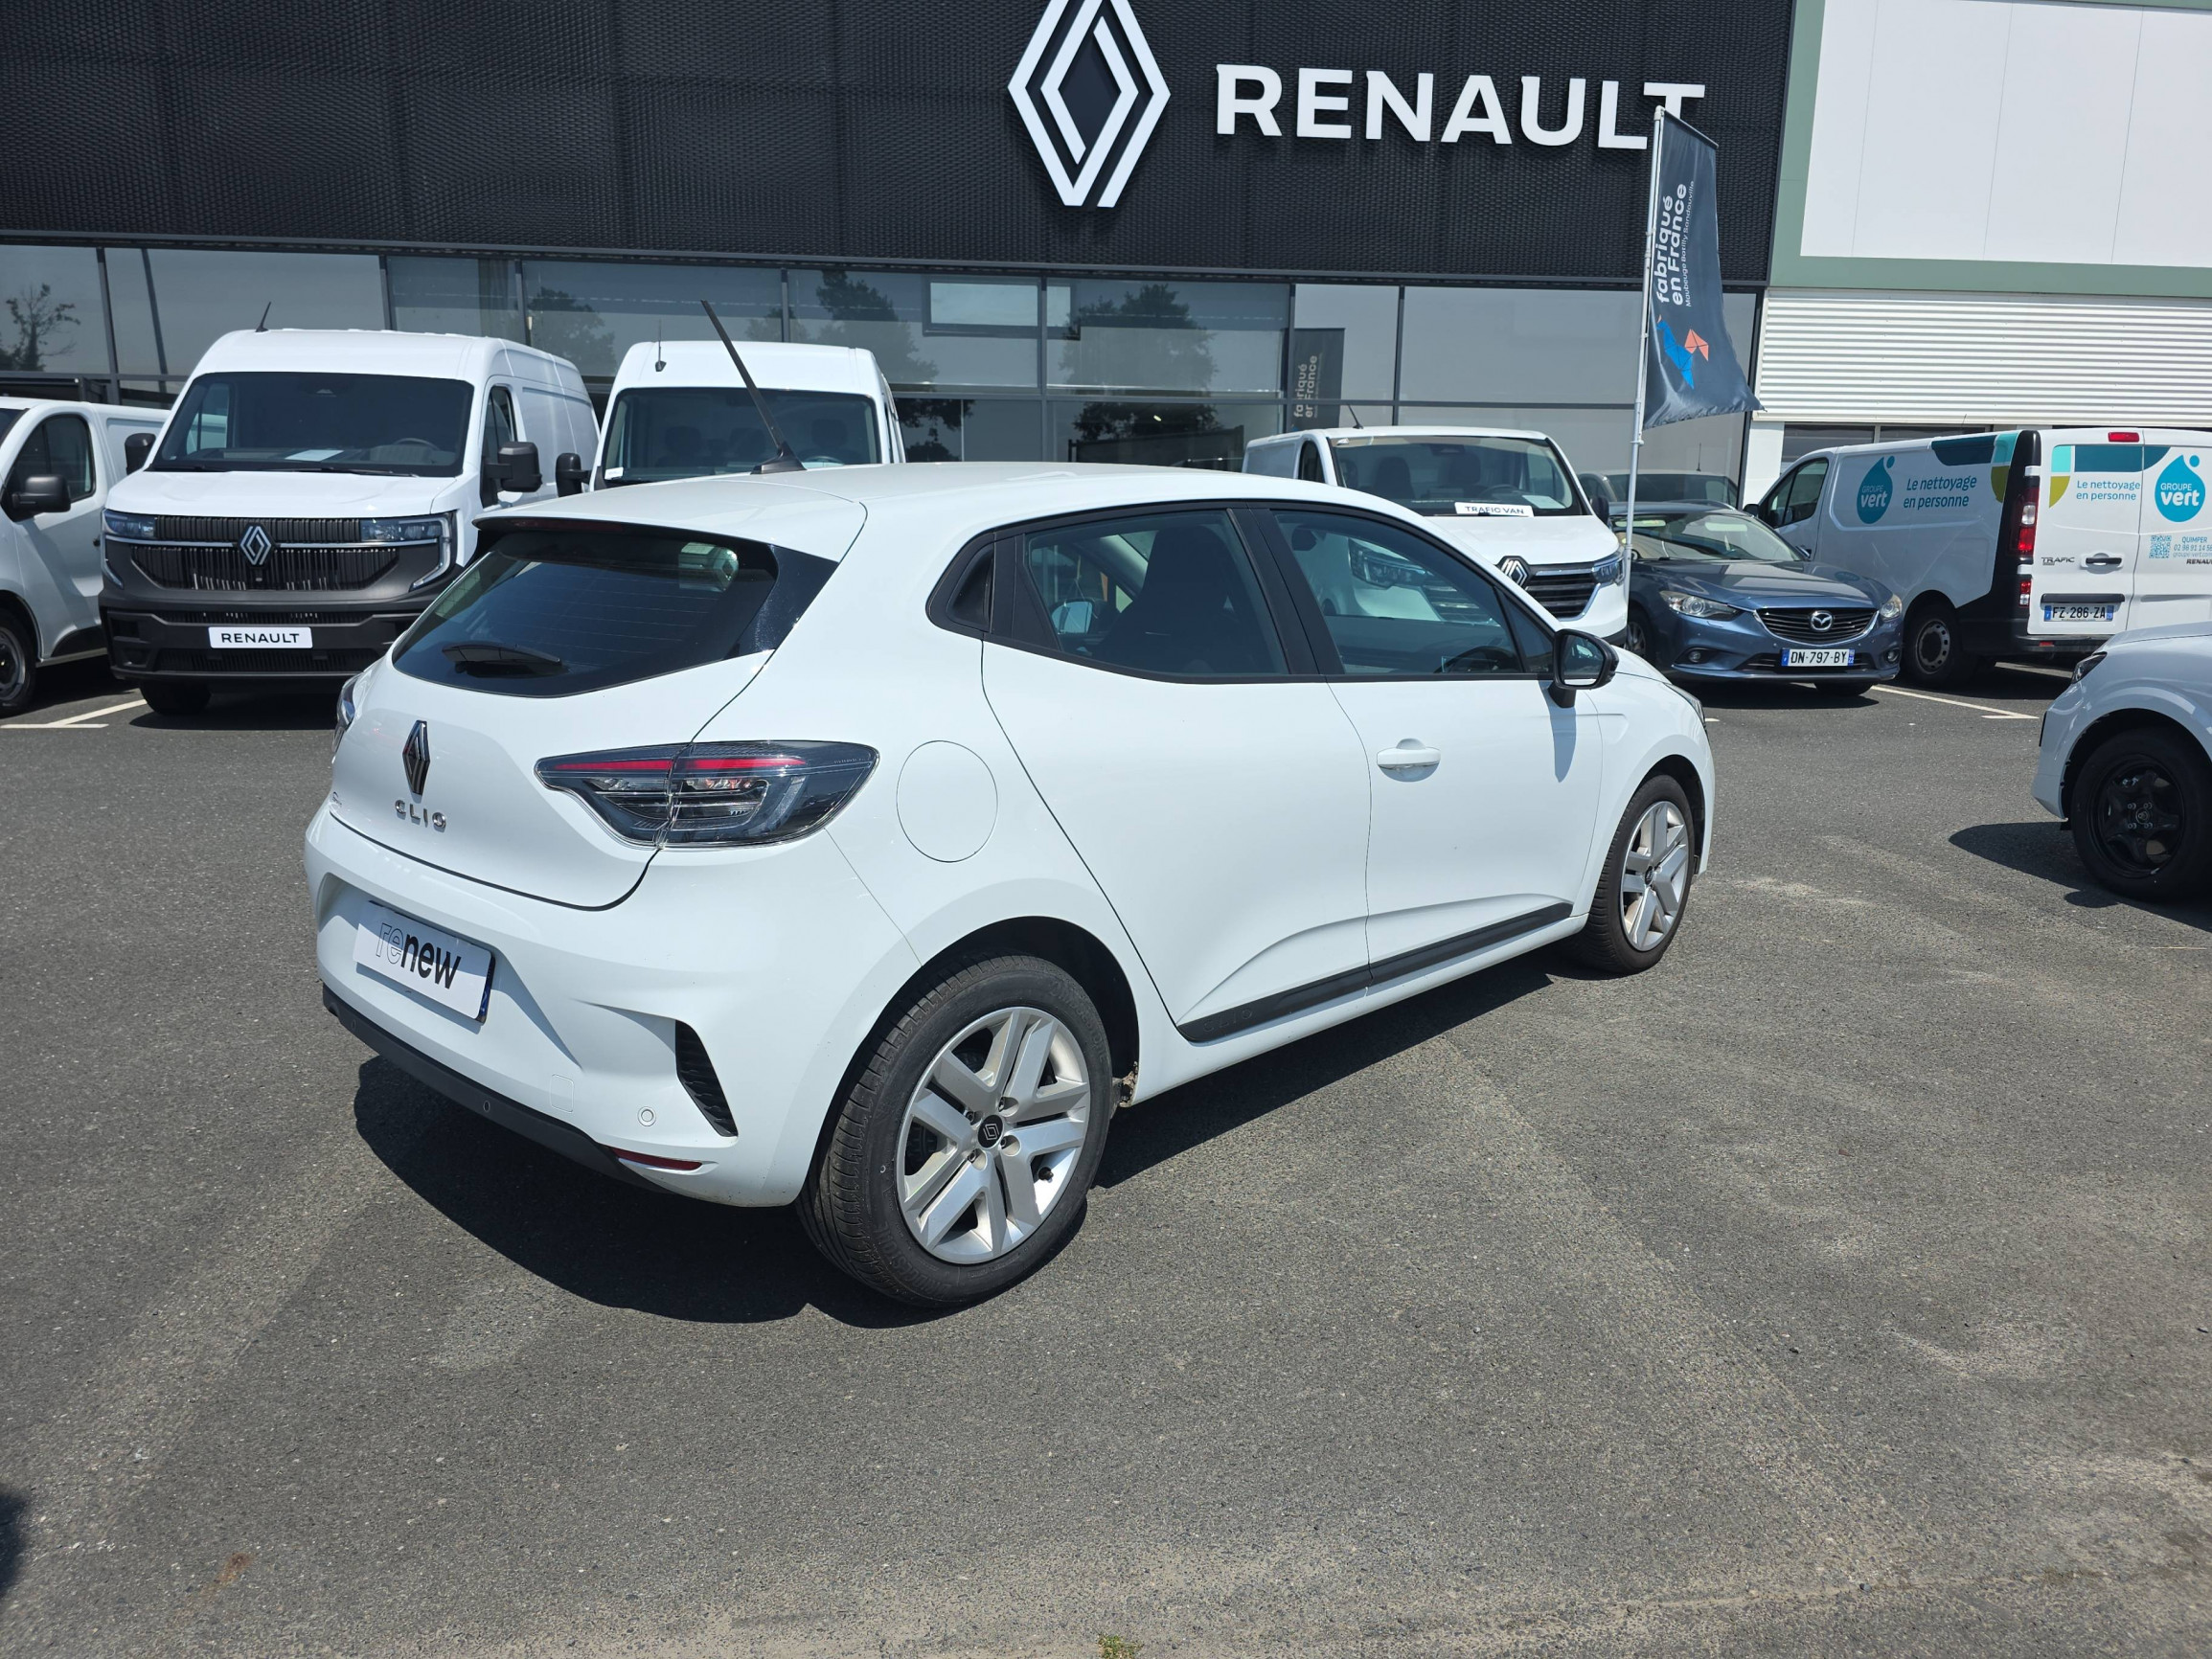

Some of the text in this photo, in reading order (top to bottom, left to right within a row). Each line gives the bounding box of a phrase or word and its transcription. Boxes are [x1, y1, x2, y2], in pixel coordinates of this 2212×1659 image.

[1216, 63, 1706, 149] RENAULT
[1654, 195, 1674, 304] fabriqué
[1668, 184, 1687, 306] en France
[1680, 180, 1695, 307] Maubeuge Batilly Sandouville
[1293, 363, 1308, 418] fariqué
[1861, 485, 1884, 493] GROUPE
[1906, 475, 1977, 491] Le nettoyage
[2077, 480, 2141, 491] Le nettoyage
[2160, 483, 2193, 491] GROUPE
[1860, 490, 1888, 508] vert
[1903, 495, 1970, 511] en personne
[2090, 492, 2136, 501] personne
[2160, 489, 2201, 507] vert
[2052, 606, 2106, 619] FZ-286-ZA
[221, 633, 300, 644] RENAULT
[1790, 651, 1847, 664] DN-797-BY
[395, 799, 447, 829] CLIO
[376, 922, 462, 989] renew
